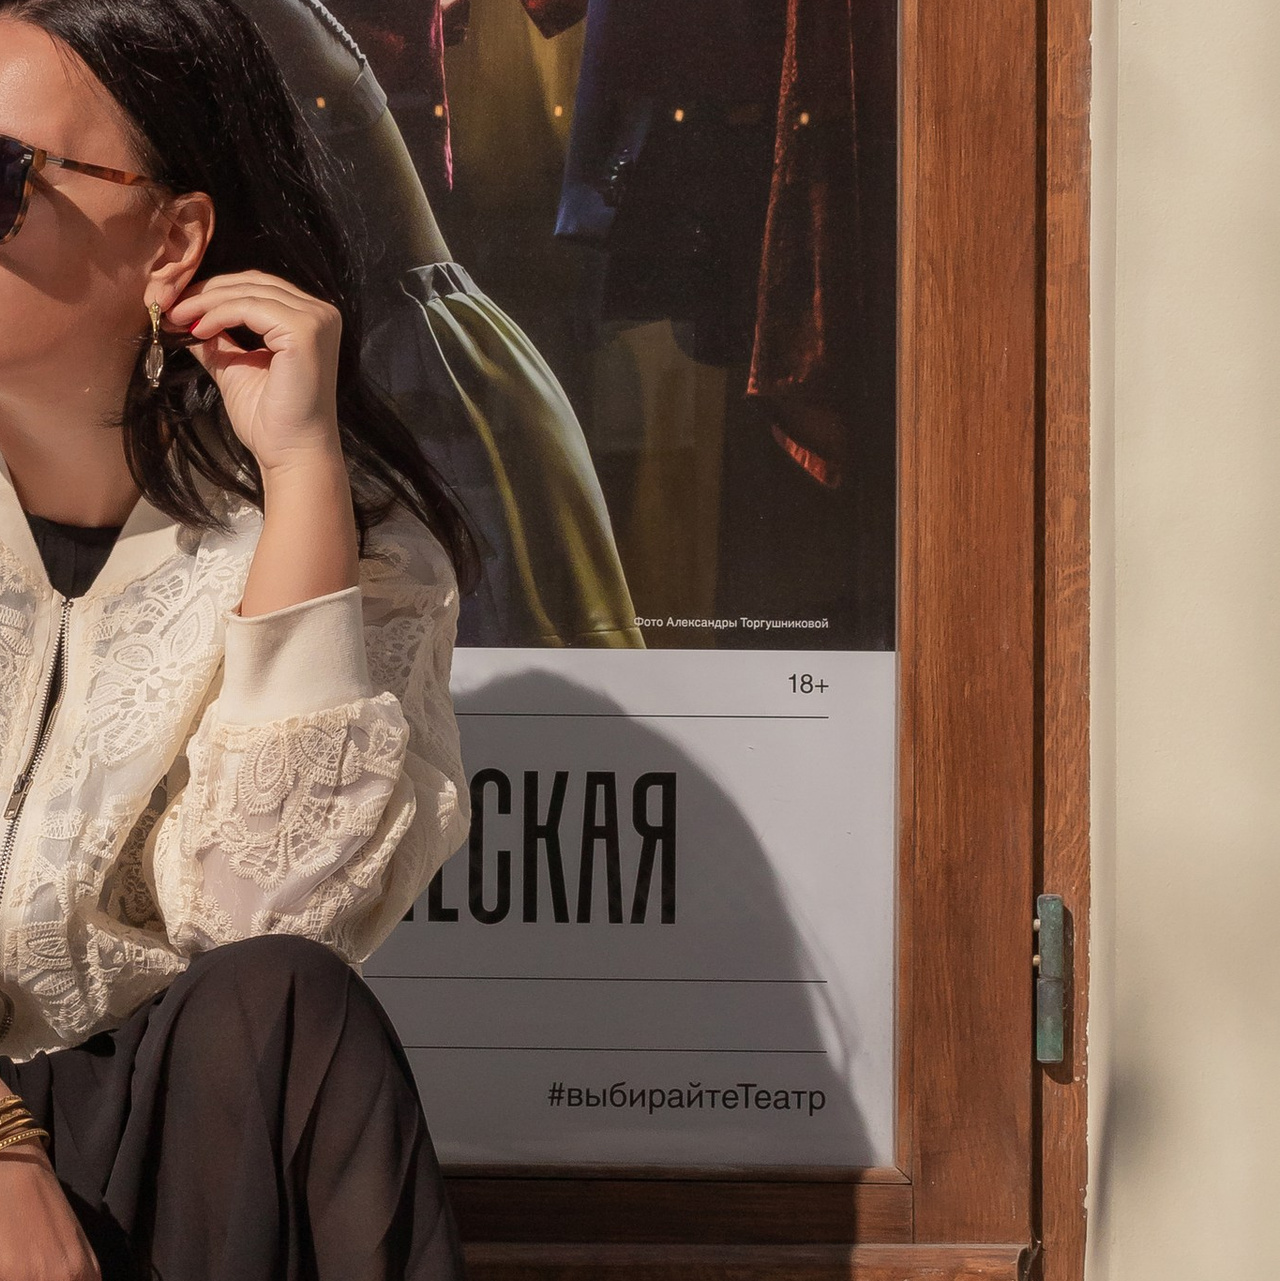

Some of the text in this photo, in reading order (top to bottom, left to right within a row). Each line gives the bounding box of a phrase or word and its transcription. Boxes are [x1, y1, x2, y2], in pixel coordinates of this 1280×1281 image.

[633, 616, 829, 631] Фото Александры Торгушниковой
[787, 673, 830, 694] 18+
[401, 768, 677, 925] СКАЯ
[547, 1081, 827, 1115] #выбирайтеТеатр
